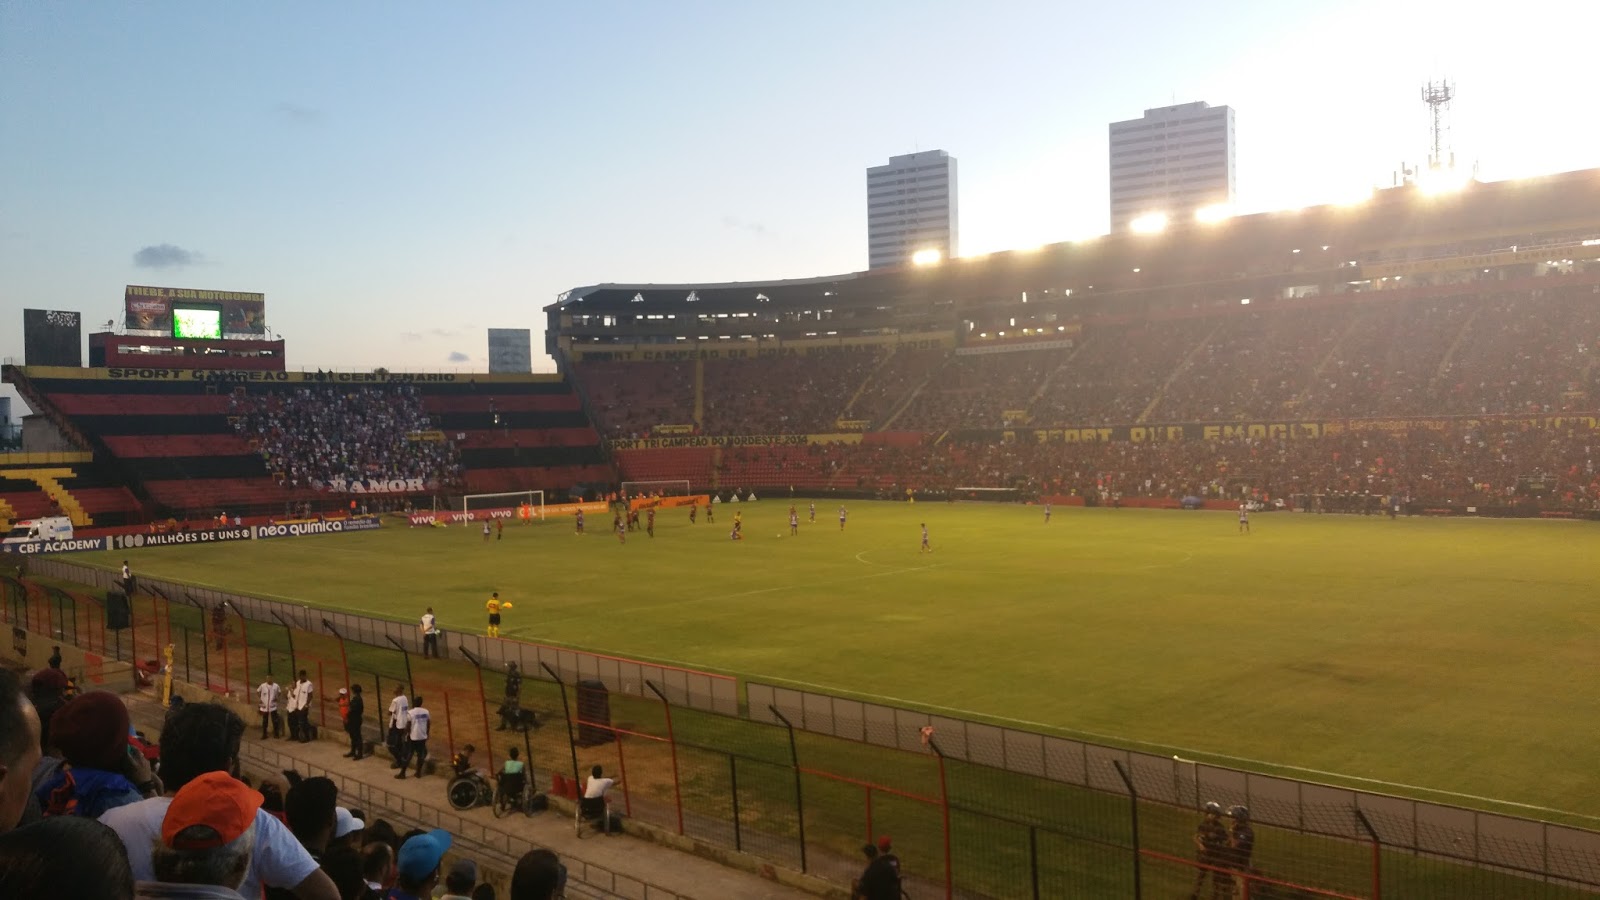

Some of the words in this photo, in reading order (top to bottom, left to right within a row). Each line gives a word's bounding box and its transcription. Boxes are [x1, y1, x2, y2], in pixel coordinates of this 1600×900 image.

[176, 289, 197, 299] SUA
[108, 368, 185, 379] SPORT
[607, 439, 641, 450] SPORT
[643, 439, 660, 449] TRI
[711, 437, 725, 446] DO
[726, 436, 783, 447] NORDESTE
[259, 525, 288, 537] neo
[115, 533, 145, 549] 100
[147, 531, 198, 545] MILHÕES
[200, 532, 215, 541] DE
[218, 529, 240, 540] UNS
[18, 542, 42, 554] CBF
[43, 538, 101, 553] ACADEMY
